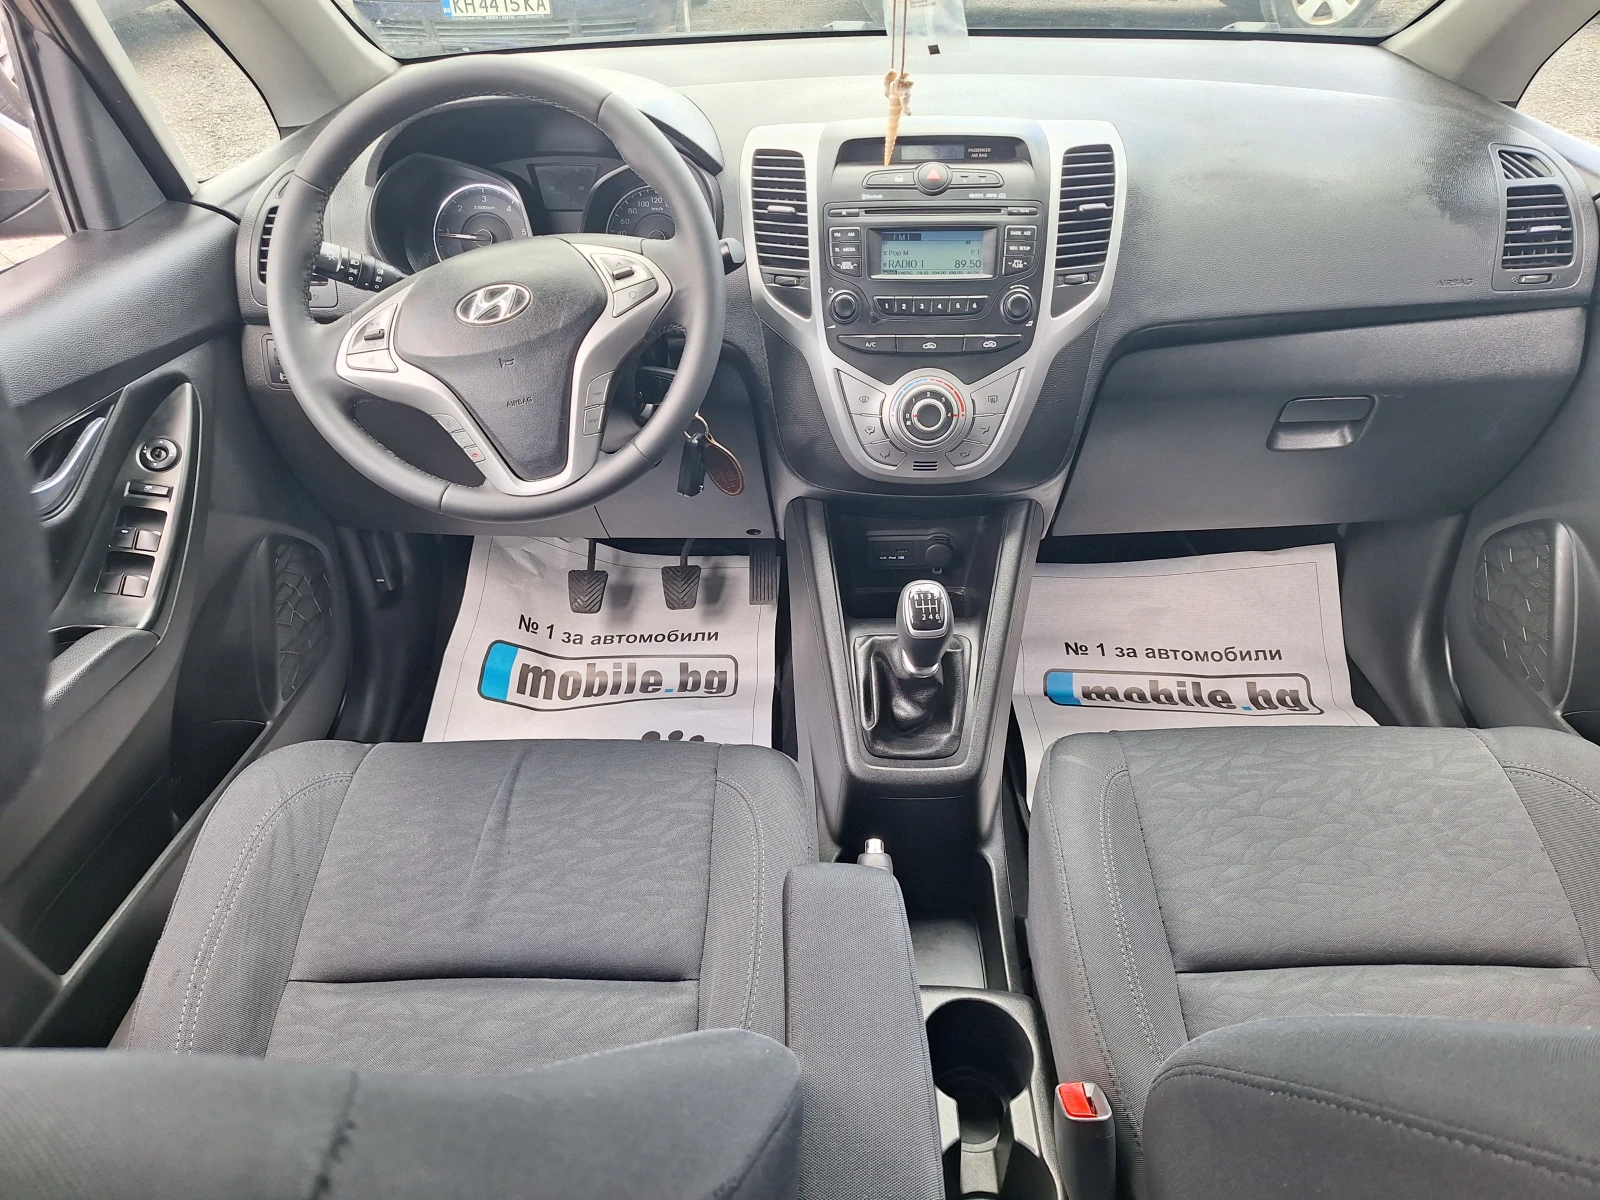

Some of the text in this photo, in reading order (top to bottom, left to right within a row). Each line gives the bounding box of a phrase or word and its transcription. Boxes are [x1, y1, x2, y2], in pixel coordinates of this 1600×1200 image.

[479, 0, 520, 13] 4415
[481, 195, 487, 203] 3
[521, 228, 527, 236] 5
[888, 259, 918, 269] RADIO
[954, 259, 982, 269] 89.50
[972, 301, 977, 309] 6
[506, 396, 533, 408] AIRBAG
[545, 624, 555, 639] 1
[561, 630, 584, 645] за
[590, 630, 719, 645] автомобили
[1096, 643, 1105, 657] 1
[1115, 645, 1138, 658] за
[1145, 647, 1283, 663] автомобили
[516, 662, 728, 701] mobile.bg
[1081, 680, 1309, 711] mobile.bg
